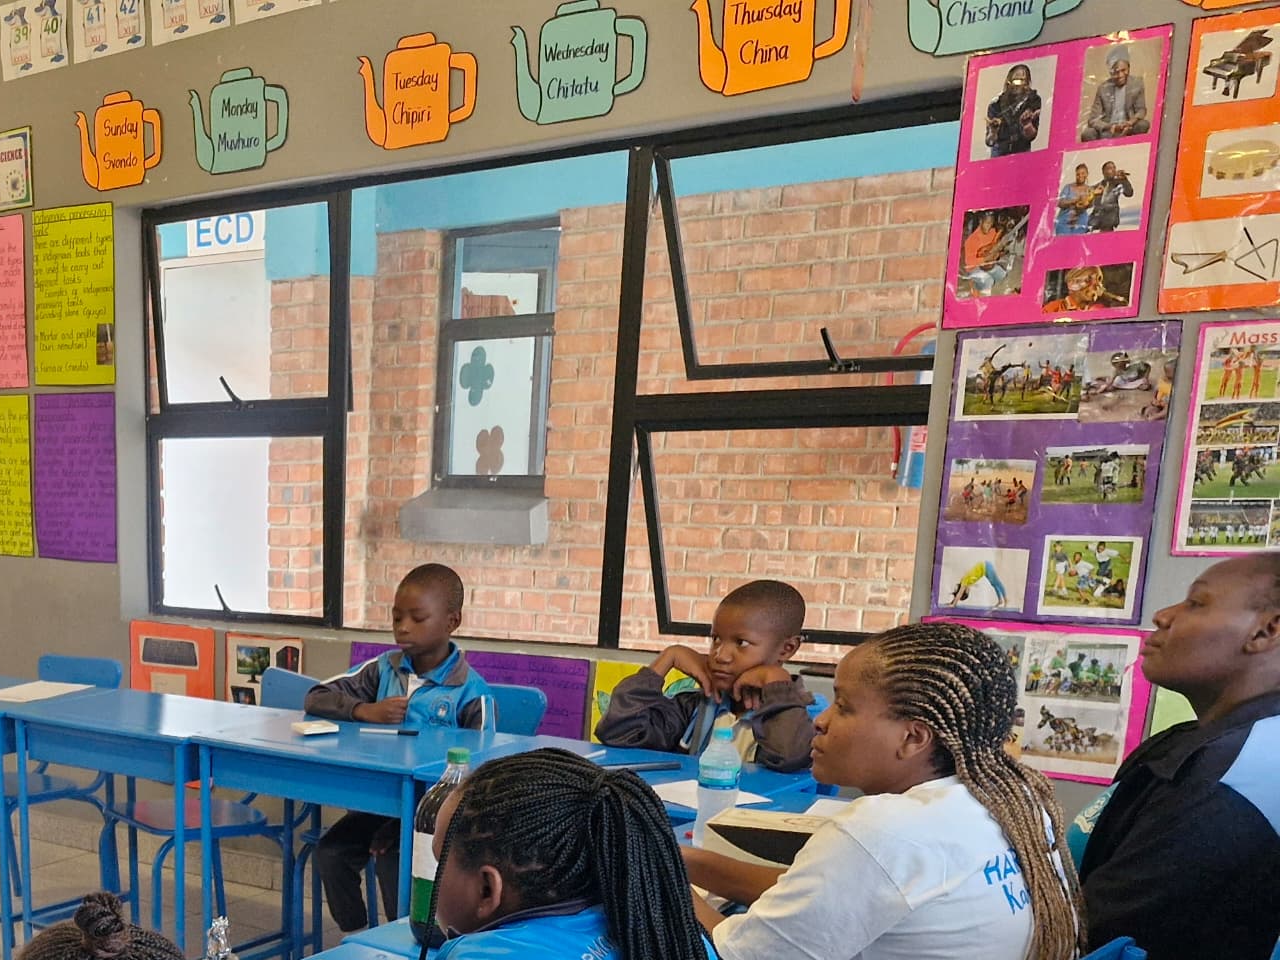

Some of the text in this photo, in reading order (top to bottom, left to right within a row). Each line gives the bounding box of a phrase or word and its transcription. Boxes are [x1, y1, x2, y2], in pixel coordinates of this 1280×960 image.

[86, 8, 100, 24] 41
[120, 0, 136, 14] 42
[732, 1, 803, 26] Thursday
[14, 26, 29, 43] 39
[44, 18, 58, 34] 40
[544, 38, 610, 63] Wednesday
[739, 41, 789, 66] China
[392, 70, 439, 91] Tuesday
[546, 77, 600, 101] Chitatu
[221, 98, 259, 119] Monday
[392, 103, 433, 130] Chipiri
[103, 119, 138, 139] Sunday
[218, 133, 260, 152] Muvhuro
[103, 152, 138, 169] Svondo
[196, 212, 254, 247] ECD
